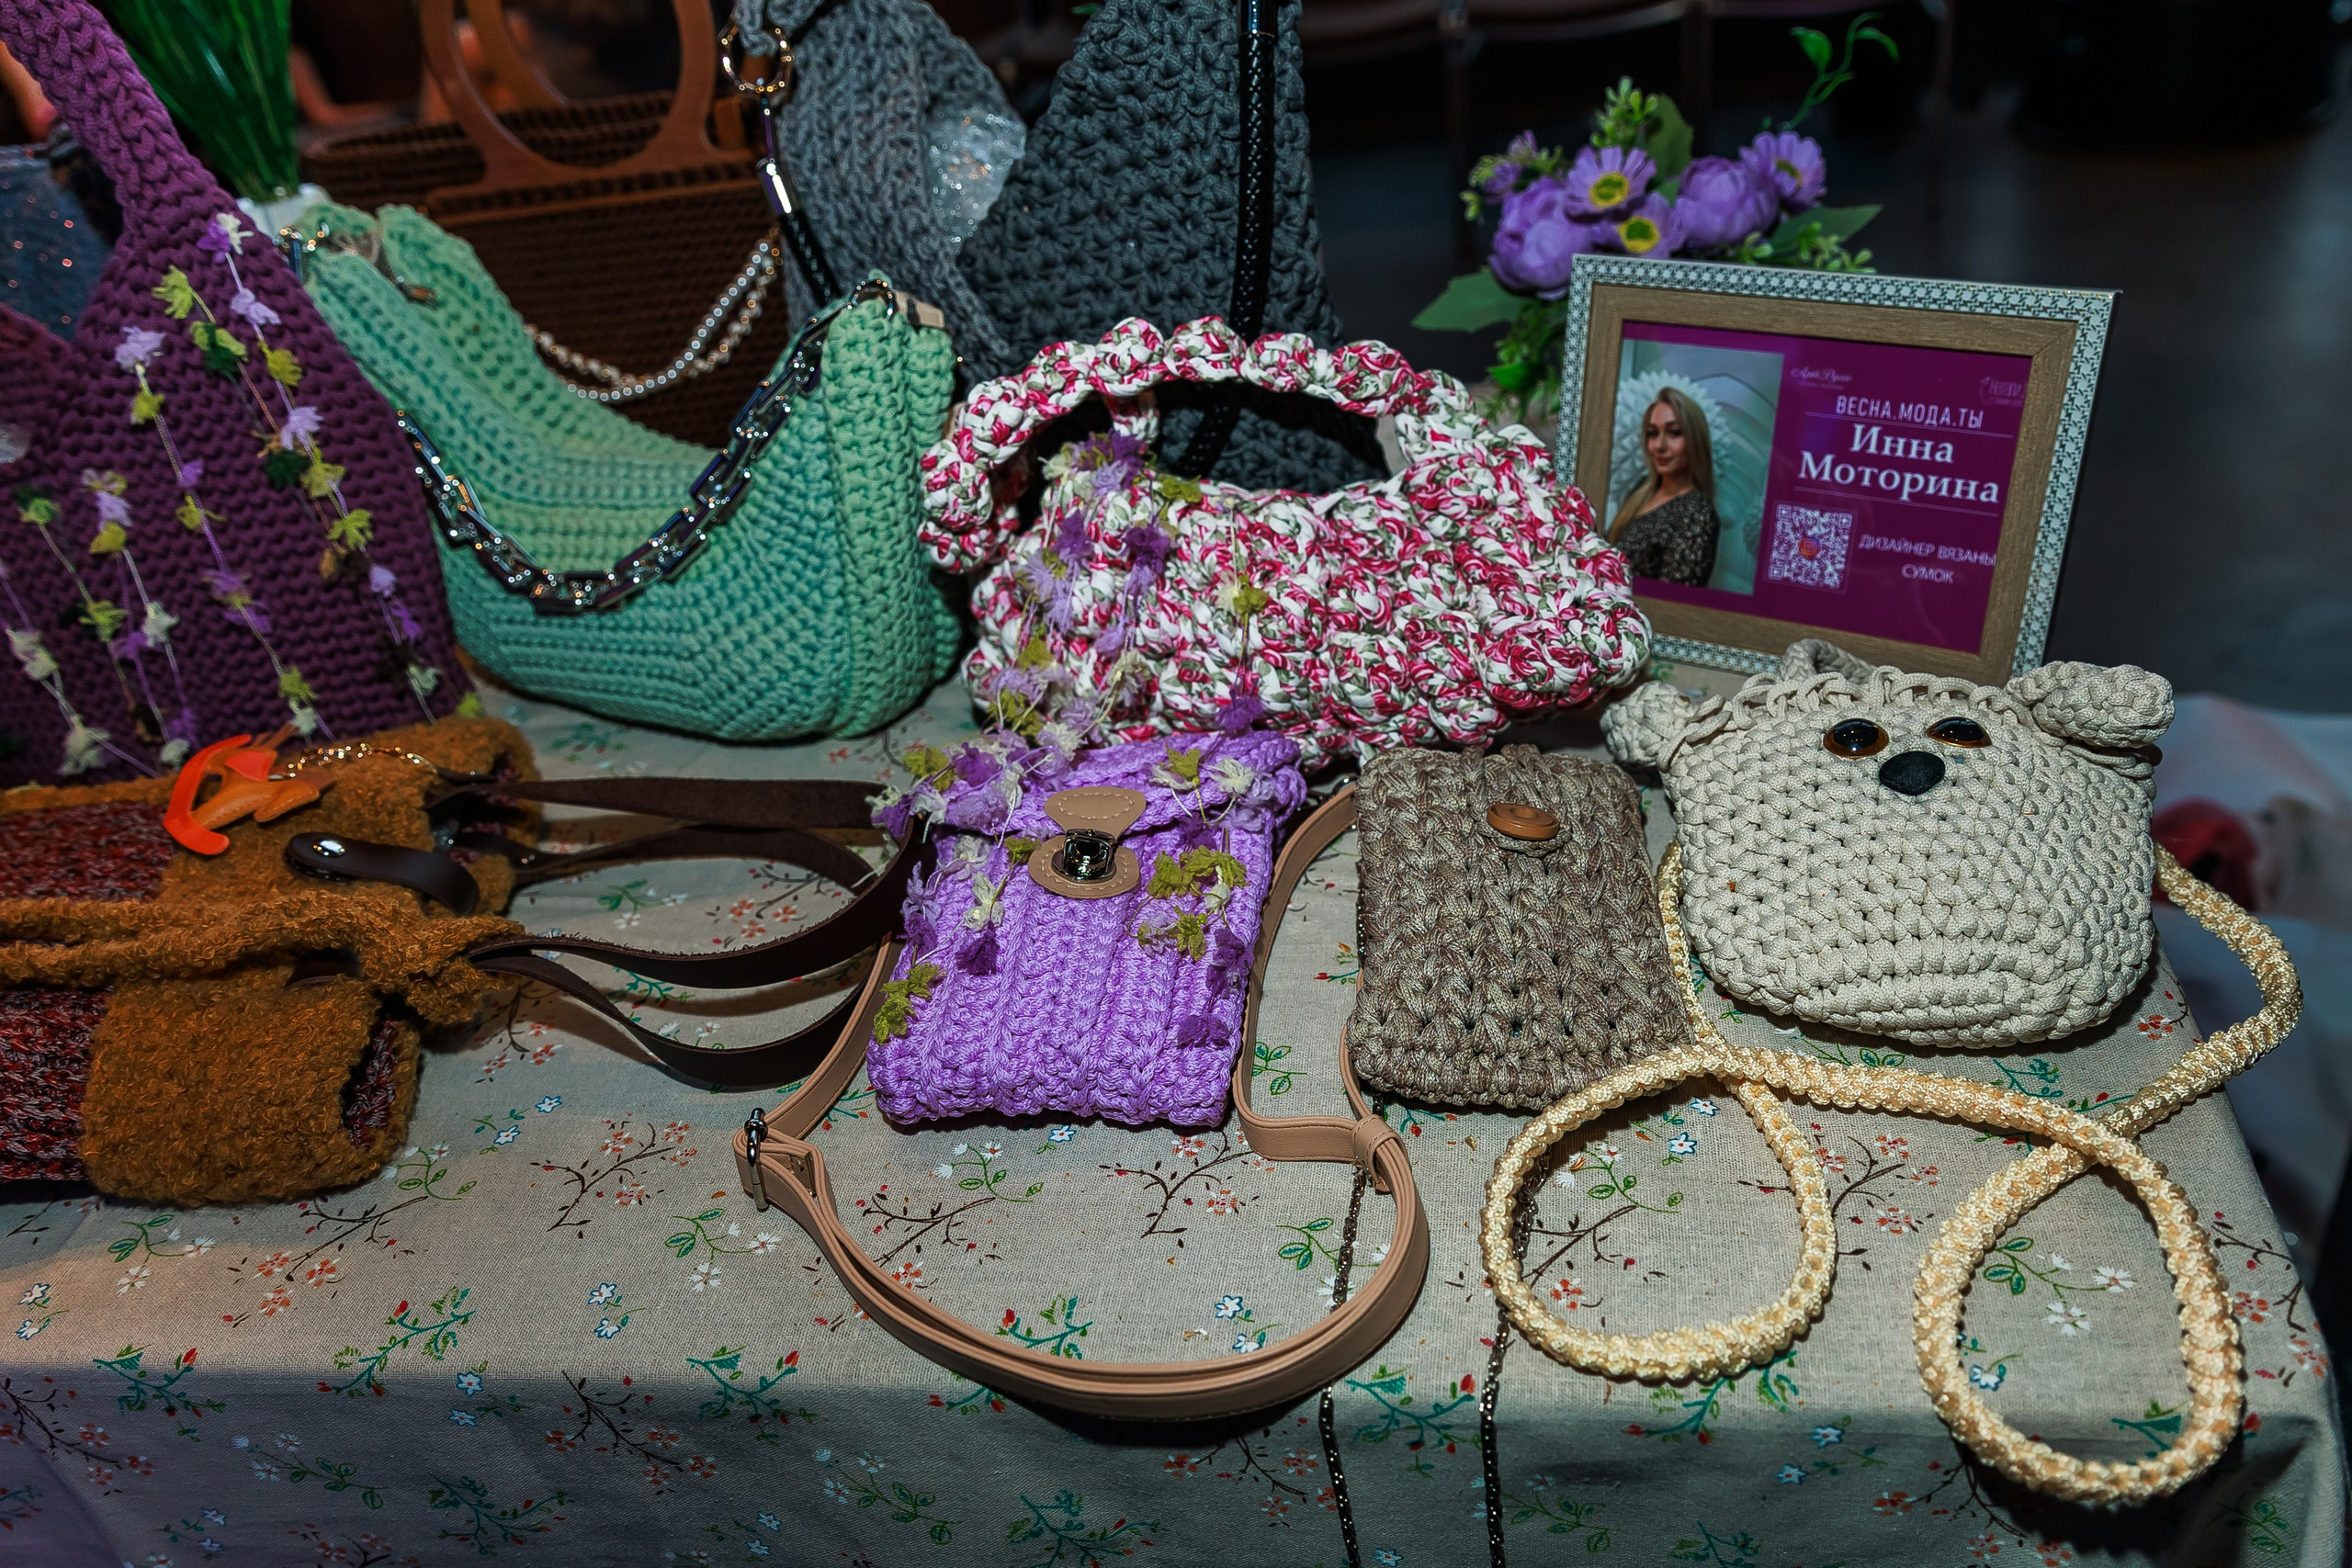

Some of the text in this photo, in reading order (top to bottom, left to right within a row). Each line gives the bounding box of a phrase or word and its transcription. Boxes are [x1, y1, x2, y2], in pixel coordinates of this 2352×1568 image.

[1836, 395, 1984, 429] ВЕСНА.МОДА.ТЫ
[1849, 423, 1954, 463] Инна
[1797, 450, 1999, 503] Моторина
[1858, 534, 1935, 557] ДИЗАЙНЕР
[1902, 563, 1954, 584] СУМОК
